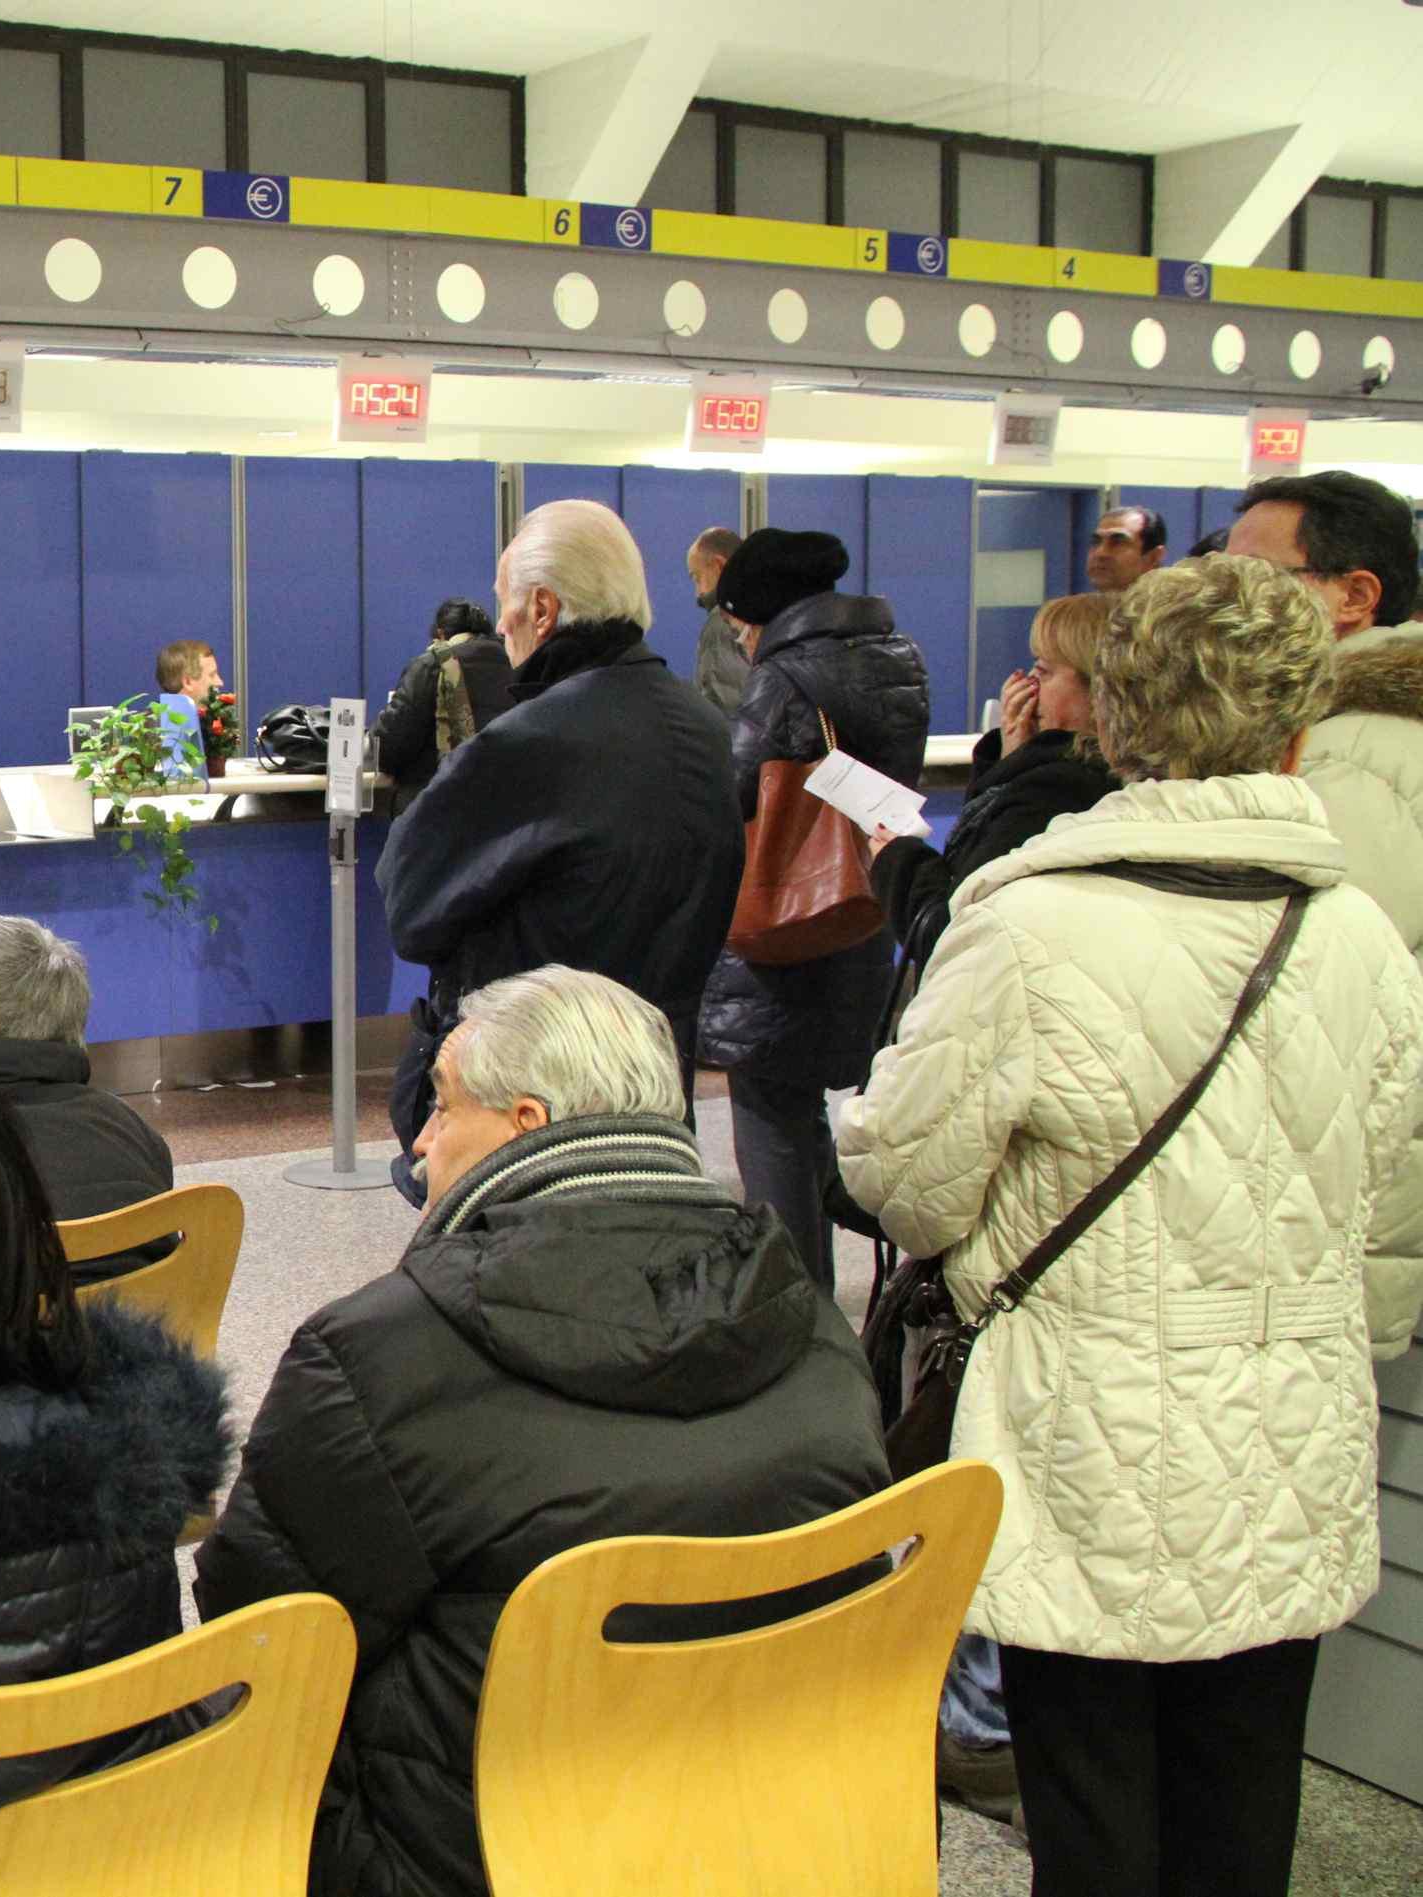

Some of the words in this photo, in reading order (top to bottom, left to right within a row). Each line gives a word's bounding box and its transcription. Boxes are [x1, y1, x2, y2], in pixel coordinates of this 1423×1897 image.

[165, 176, 182, 206] 7
[554, 208, 570, 236] 6
[864, 237, 879, 263] 5
[1062, 256, 1075, 279] 4
[703, 400, 759, 430] C628
